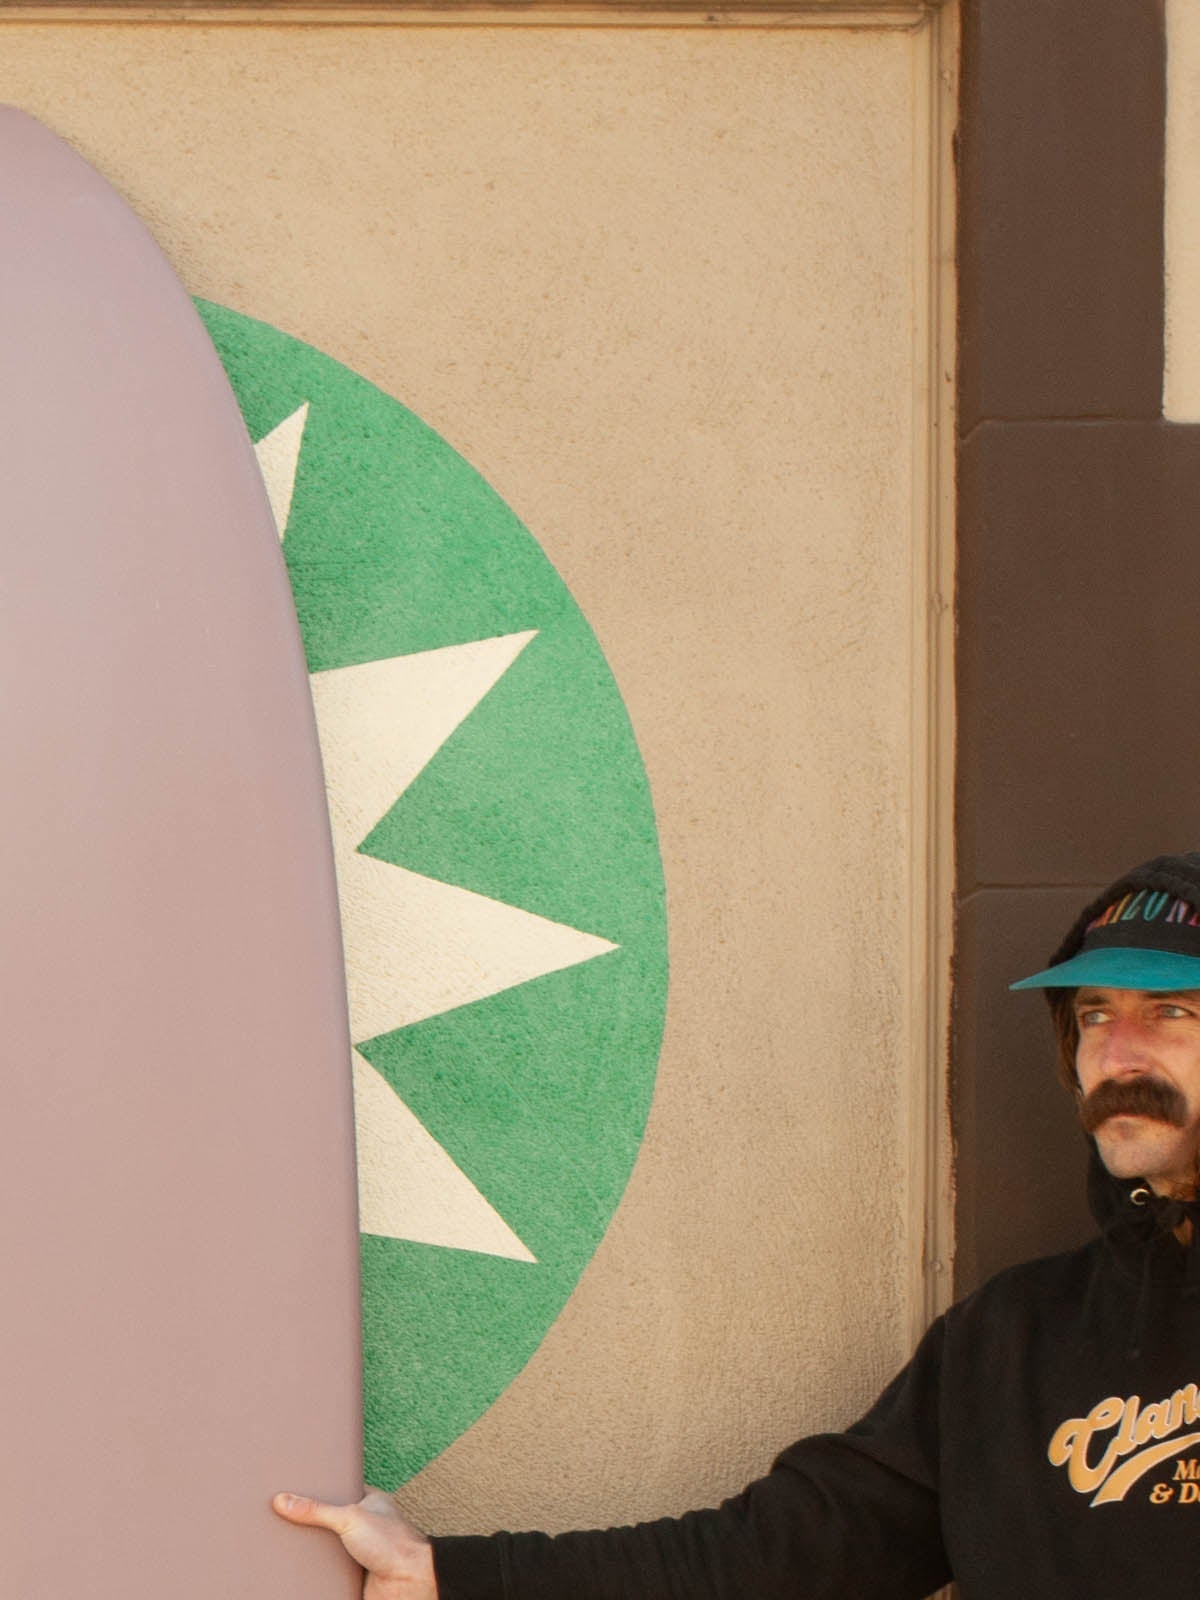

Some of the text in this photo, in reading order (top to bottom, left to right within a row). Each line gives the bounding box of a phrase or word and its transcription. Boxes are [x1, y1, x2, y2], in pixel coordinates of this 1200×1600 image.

[1048, 1382, 1200, 1494] Clan
[1149, 1482, 1200, 1503] & D
